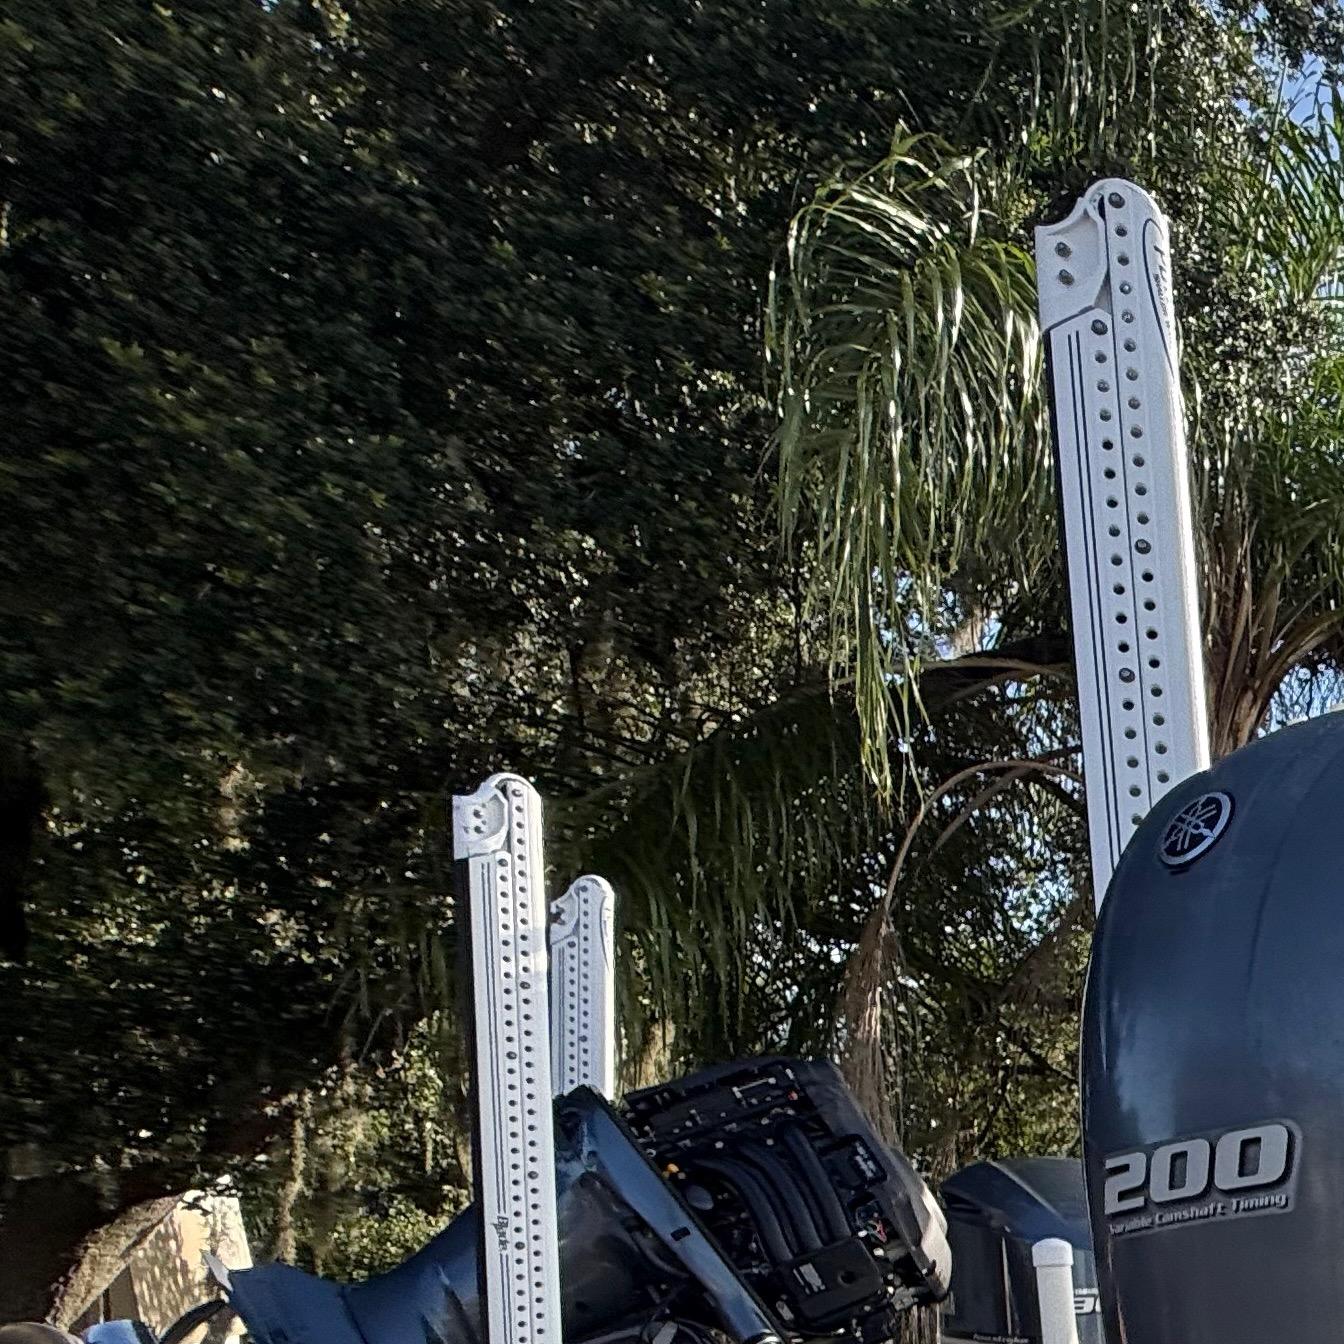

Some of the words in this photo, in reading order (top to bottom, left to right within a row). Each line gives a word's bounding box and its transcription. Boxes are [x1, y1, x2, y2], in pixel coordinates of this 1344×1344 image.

[1104, 1124, 1289, 1215] 200
[1154, 1201, 1227, 1225] Camshaft
[1231, 1192, 1288, 1214] Timing
